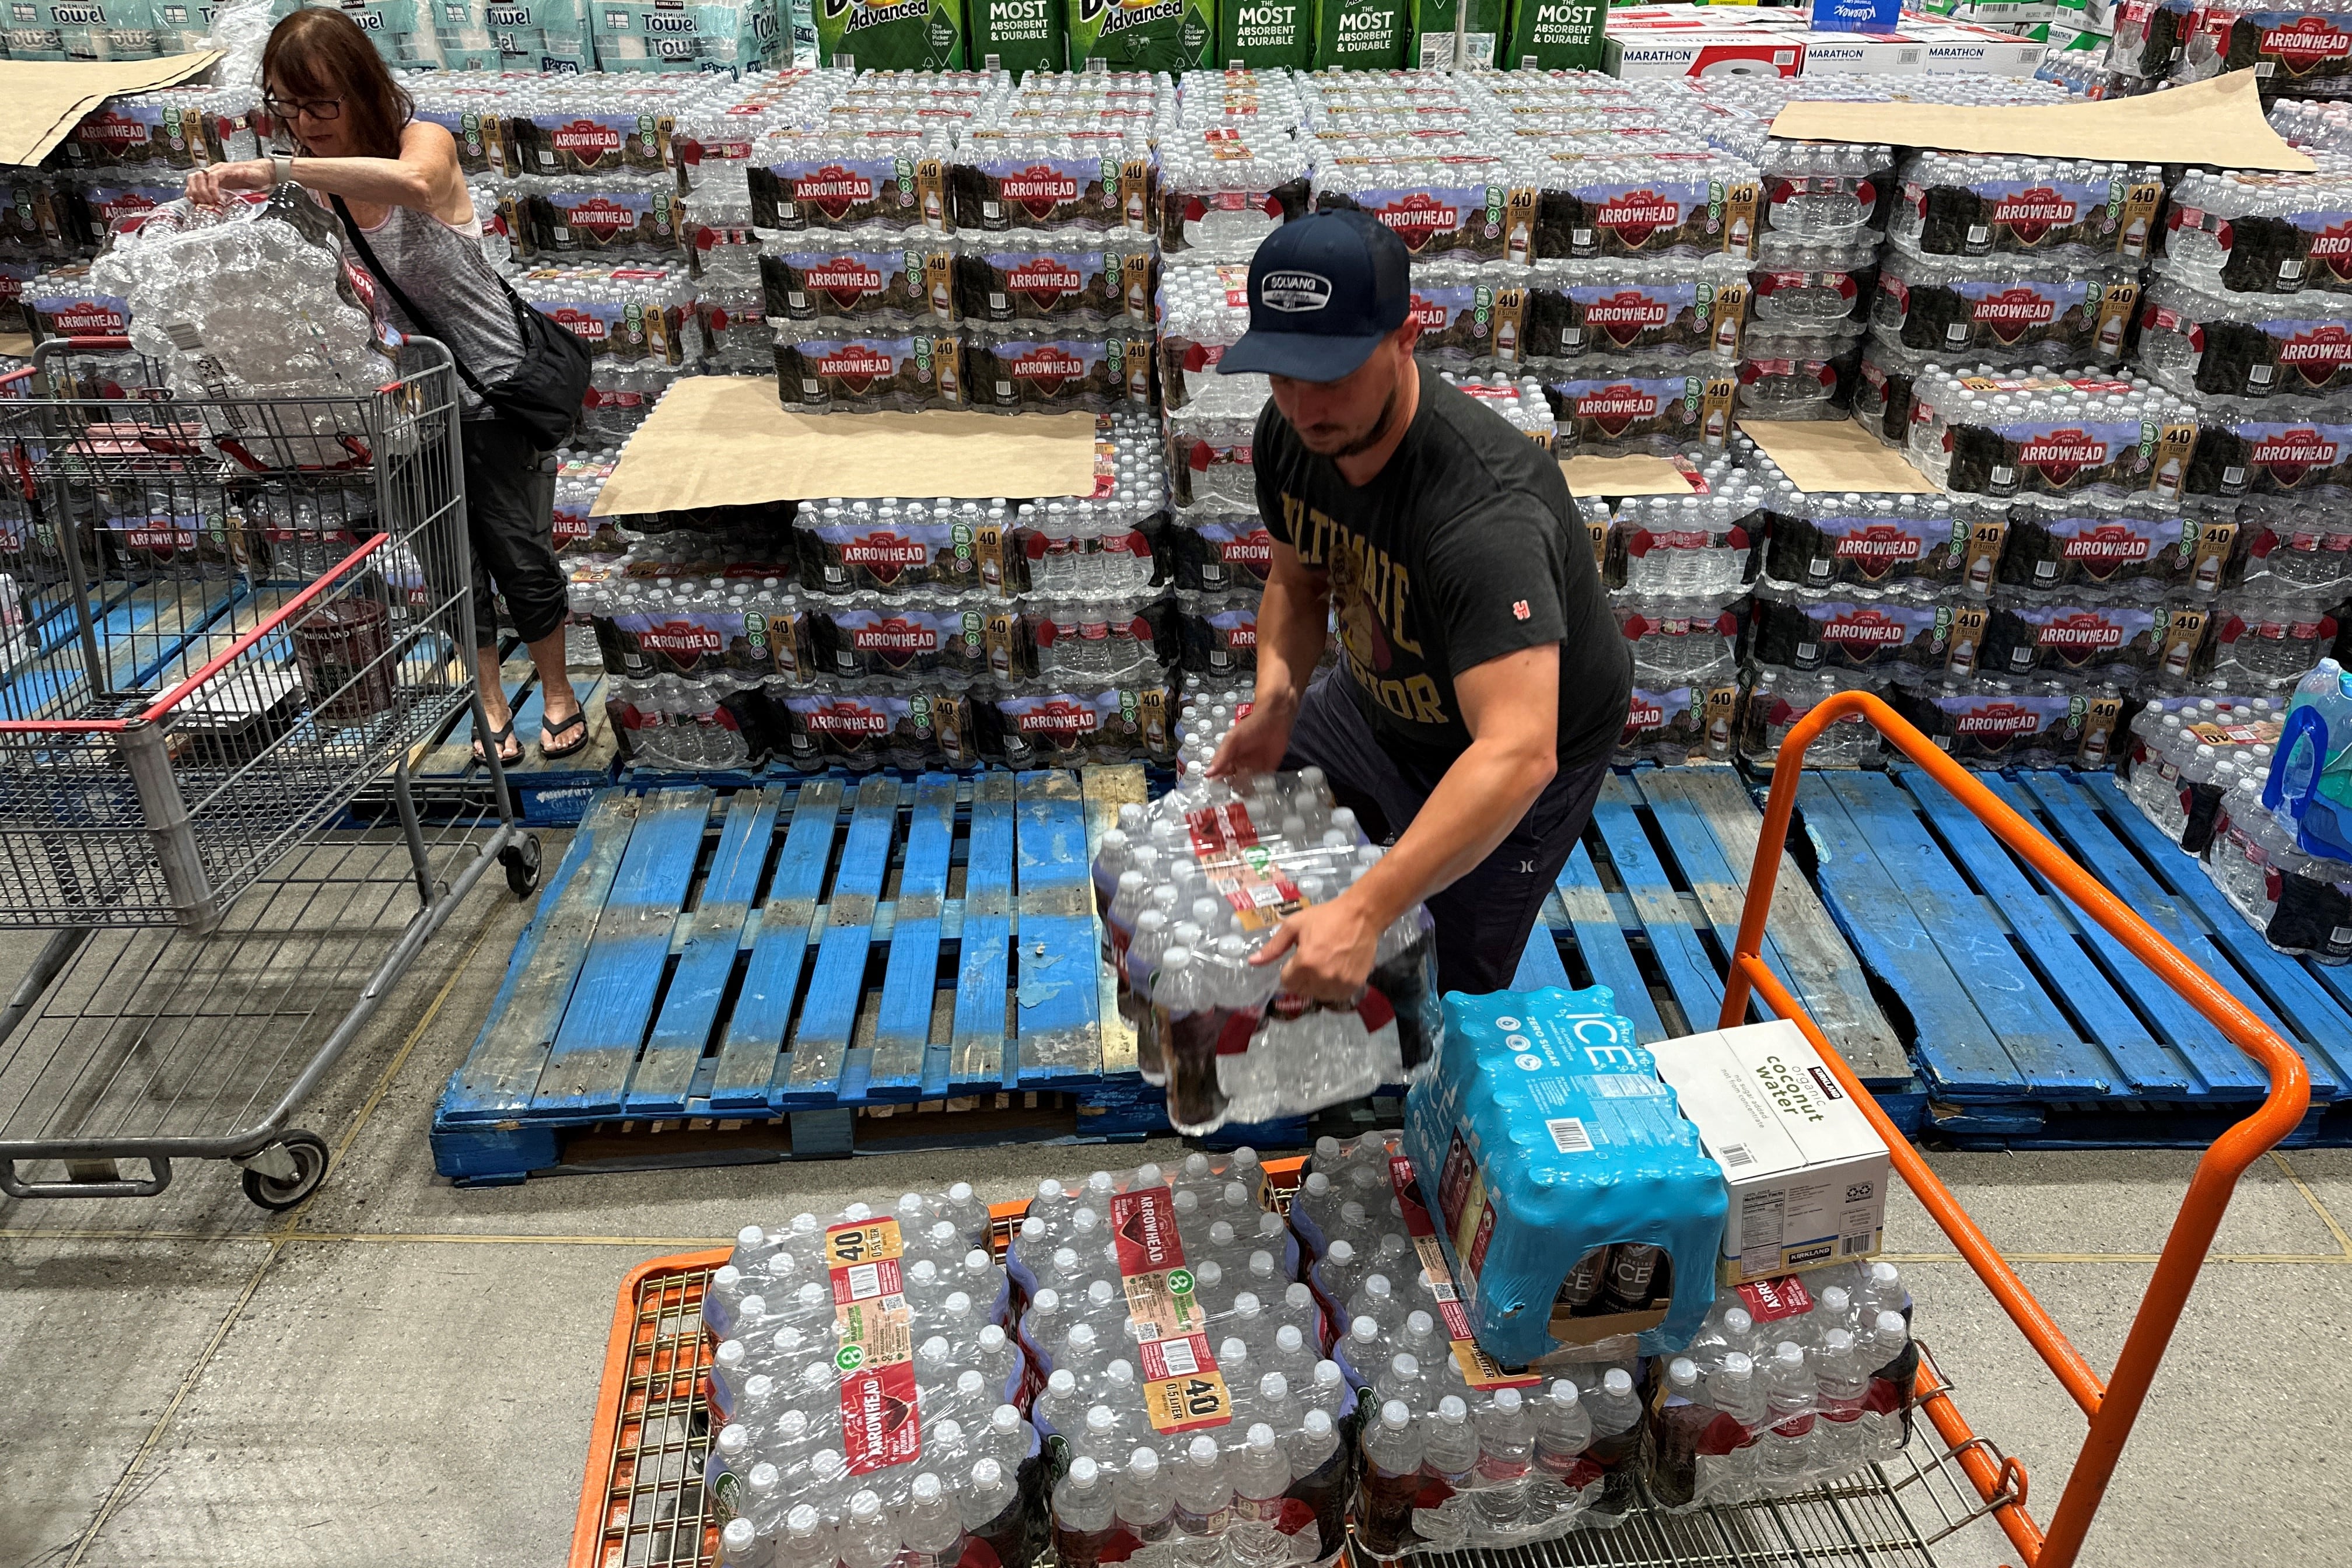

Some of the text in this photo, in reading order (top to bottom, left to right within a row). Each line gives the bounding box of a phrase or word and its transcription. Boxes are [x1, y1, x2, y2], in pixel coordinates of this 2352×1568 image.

[49, 6, 107, 24] Towel
[846, 0, 930, 33] Advanced
[991, 2, 1046, 19] MOST
[1238, 6, 1296, 24] MOST
[1537, 6, 1597, 23] MOST
[1833, 5, 1876, 20] Kleenex
[642, 13, 698, 32] Towel
[991, 20, 1048, 30] ABSORBENT
[1100, 2, 1183, 37] Advanced
[1339, 11, 1394, 31] MOST
[991, 30, 1048, 41] & DURABLE
[1238, 26, 1296, 36] ABSORBENT
[1338, 30, 1392, 41] ABSORBENT
[1535, 24, 1594, 34] ABSORBENT
[1237, 36, 1294, 46] & DURABLE
[1337, 40, 1391, 52] & DURABLE
[1533, 34, 1590, 44] & DURABLE
[2265, 32, 2348, 50] ARROWHEAD
[1623, 51, 1692, 61] MARATHON
[1808, 50, 1863, 58] MARATHON
[1929, 48, 1985, 57] MARATHON
[184, 110, 197, 124] 40
[484, 117, 495, 130] 40
[82, 125, 144, 137] ARROWHEAD
[659, 120, 673, 132] 40
[556, 132, 617, 149] ARROWHEAD
[921, 163, 937, 178] 40
[1125, 166, 1142, 178] 40
[797, 181, 869, 197] ARROWHEAD
[1004, 182, 1074, 197] ARROWHEAD
[1731, 188, 1752, 204] 40
[2130, 187, 2157, 204] 40
[1511, 191, 1532, 208] 40
[572, 212, 631, 223] ARROWHEAD
[1598, 206, 1675, 222] ARROWHEAD
[1995, 204, 2073, 219] ARROWHEAD
[1378, 211, 1453, 227] ARROWHEAD
[929, 257, 946, 271] 40
[1126, 259, 1143, 271] 40
[809, 273, 878, 286] ARROWHEAD
[1010, 274, 1077, 287] ARROWHEAD
[1271, 276, 1316, 290] SOLVANG
[1498, 294, 1519, 309] 40
[1720, 290, 1740, 303] 40
[2108, 288, 2134, 302] 40
[646, 310, 659, 320] 40
[1587, 307, 1664, 321] ARROWHEAD
[1975, 304, 2050, 318] ARROWHEAD
[58, 315, 121, 330] ARROWHEAD
[936, 342, 951, 355] 40
[1129, 344, 1145, 358] 40
[822, 359, 889, 373] ARROWHEAD
[1015, 361, 1082, 374] ARROWHEAD
[1706, 383, 1728, 397] 40
[1578, 399, 1653, 414] ARROWHEAD
[2165, 430, 2192, 444] 40
[2021, 446, 2102, 461] ARROWHEAD
[2253, 445, 2332, 461] ARROWHEAD
[979, 532, 995, 545] 40
[1976, 528, 1998, 541] 40
[2204, 527, 2230, 543] 40
[846, 547, 923, 561] ARROWHEAD
[1838, 541, 1916, 555] ARROWHEAD
[2065, 542, 2145, 556] ARROWHEAD
[772, 621, 788, 633] 40
[990, 621, 1005, 633] 40
[1959, 614, 1980, 628] 40
[2176, 616, 2199, 629] 40
[1824, 625, 1901, 639] ARROWHEAD
[2041, 629, 2119, 644] ARROWHEAD
[645, 635, 718, 649] ARROWHEAD
[858, 633, 933, 647] ARROWHEAD
[1142, 694, 1160, 706] 40
[1712, 692, 1731, 705] 40
[937, 702, 952, 715] 40
[2094, 704, 2114, 716] 40
[811, 716, 884, 730] ARROWHEAD
[1023, 713, 1093, 729] ARROWHEAD
[1959, 716, 2036, 730] ARROWHEAD
[1526, 1016, 1545, 1038] ZERO
[1539, 1038, 1561, 1068] SUGAR
[1546, 1020, 1574, 1062] SPARKLING WATER
[1559, 1027, 1576, 1052] FLAVORED
[1566, 1012, 1637, 1068] ICE
[1756, 1066, 1799, 1115] water
[1767, 1056, 1824, 1122] coconut
[1792, 1066, 1826, 1107] organic
[1813, 1068, 1840, 1099] KIRKLAND
[1721, 1069, 1765, 1129] not from concentrate
[1734, 1074, 1769, 1119] no sugar added
[1140, 1196, 1163, 1261] ARROWHEAD
[835, 1231, 865, 1261] 40
[1791, 1247, 1830, 1261] KIRKLAND
[1612, 1257, 1651, 1284] ICE
[1476, 1357, 1494, 1379] LITER
[1166, 1383, 1183, 1420] 0.5 LITER
[1185, 1380, 1220, 1416] 40
[863, 1380, 883, 1455] ARROWHEAD
